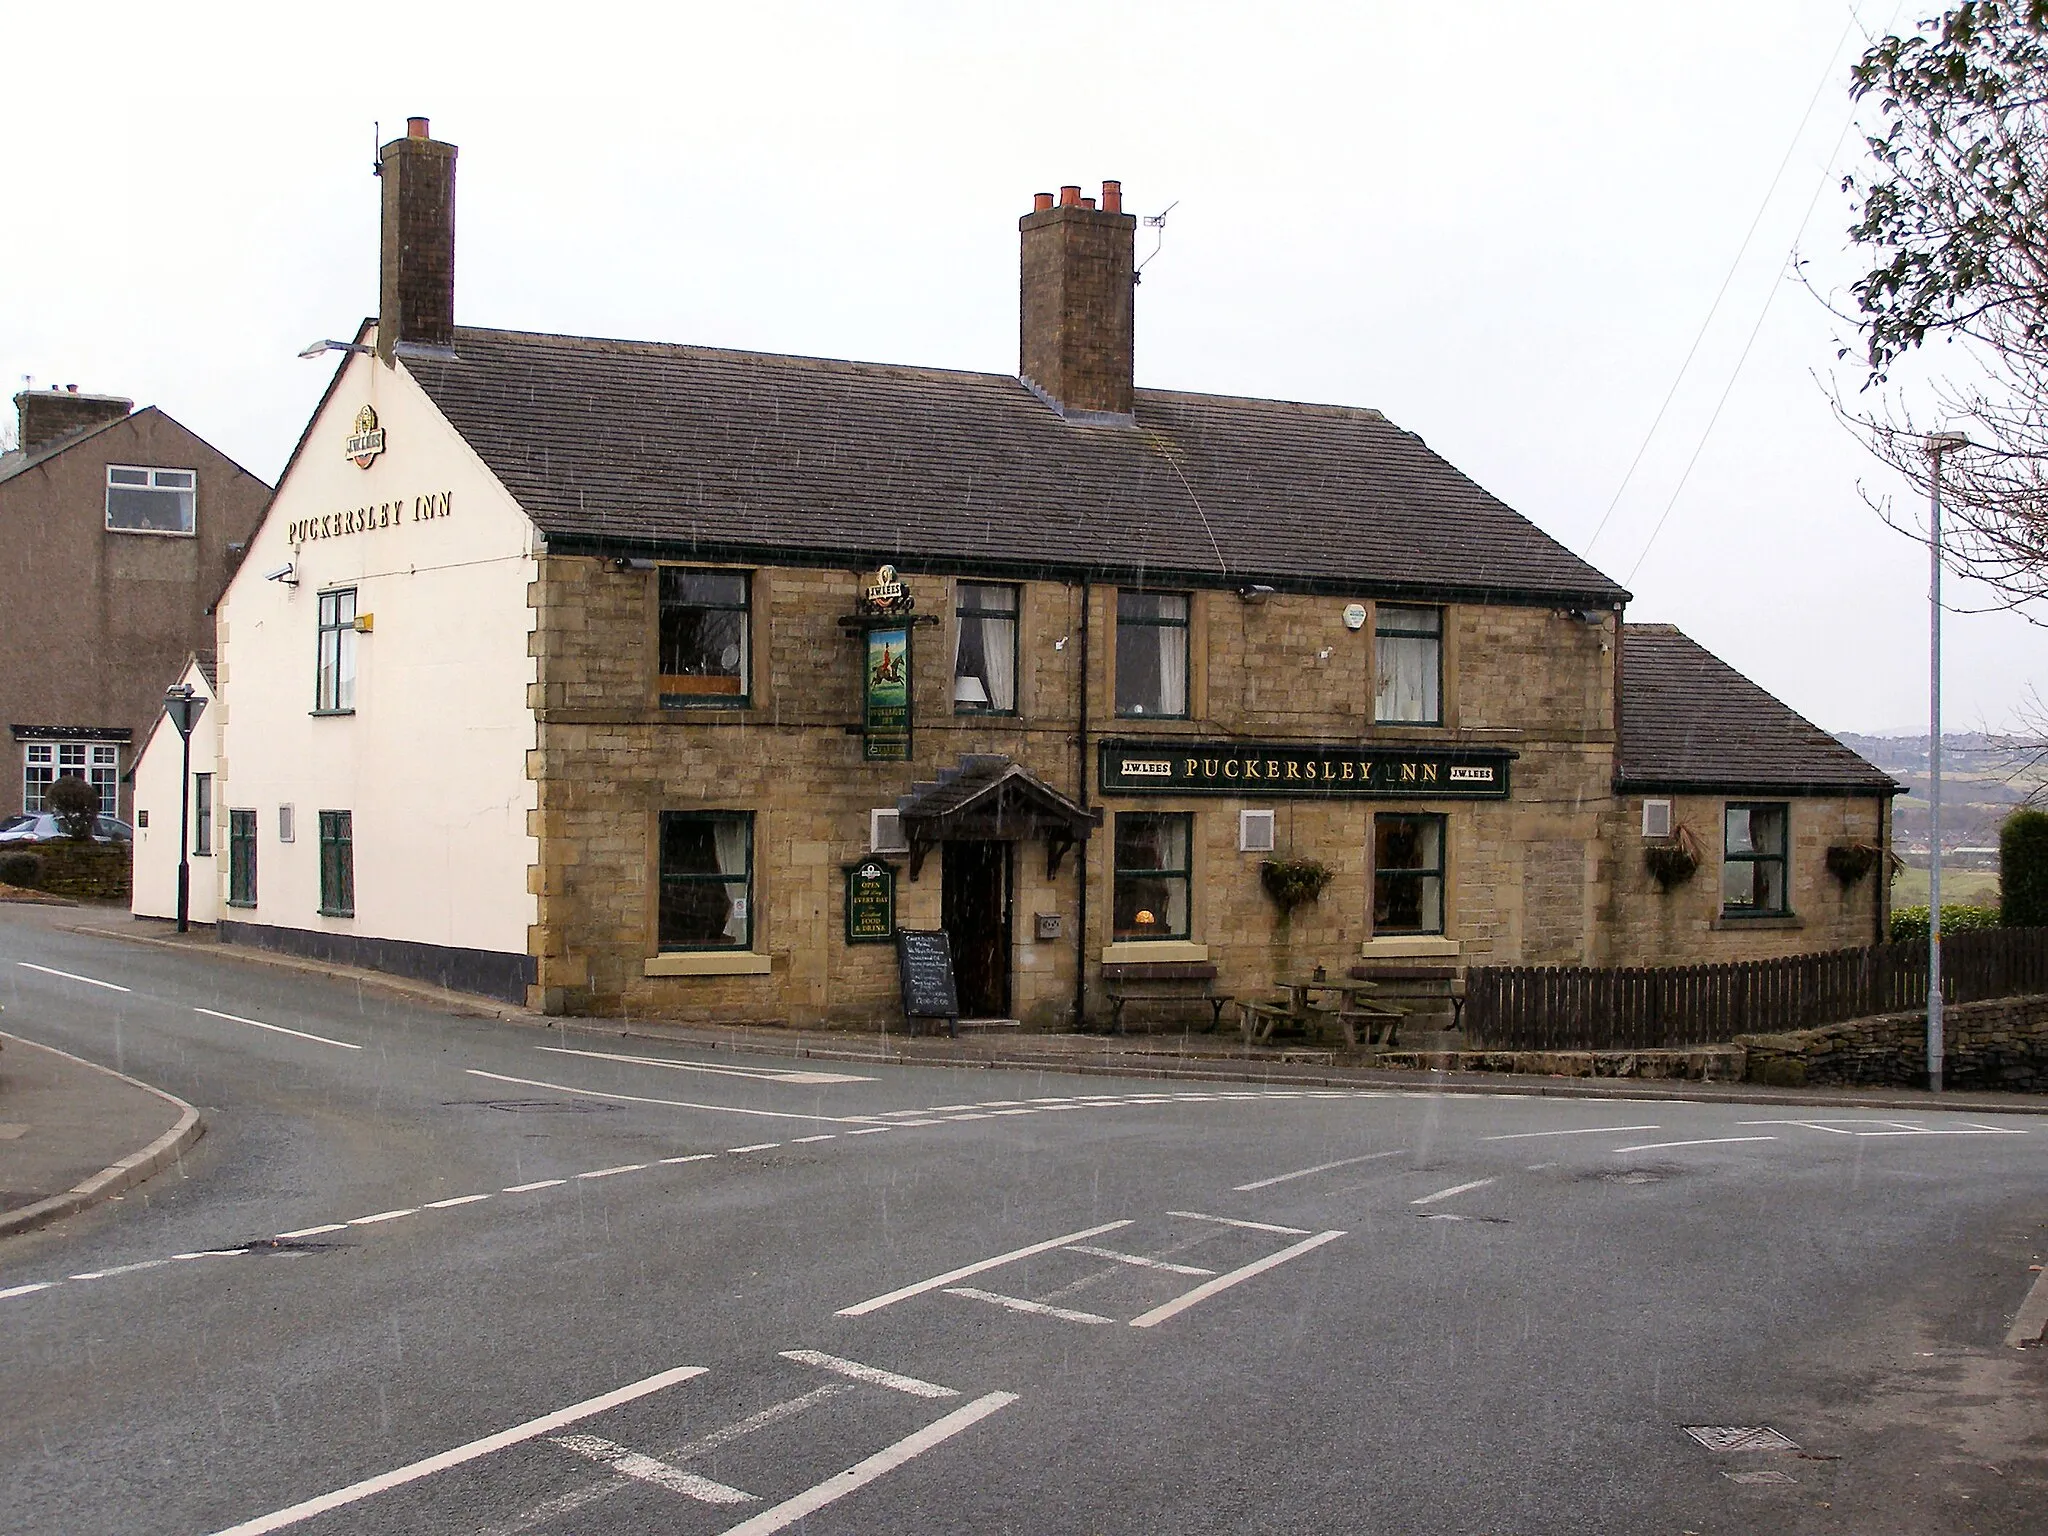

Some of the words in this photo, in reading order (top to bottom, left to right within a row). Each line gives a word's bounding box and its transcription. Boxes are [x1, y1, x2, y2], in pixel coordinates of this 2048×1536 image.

[288, 500, 402, 545] PUCKERSLEY
[413, 490, 452, 522] INN
[1125, 763, 1168, 773] J.W.LEES
[1184, 758, 1373, 781] PUCKERSLEY
[1452, 769, 1491, 778] J.W.LEES
